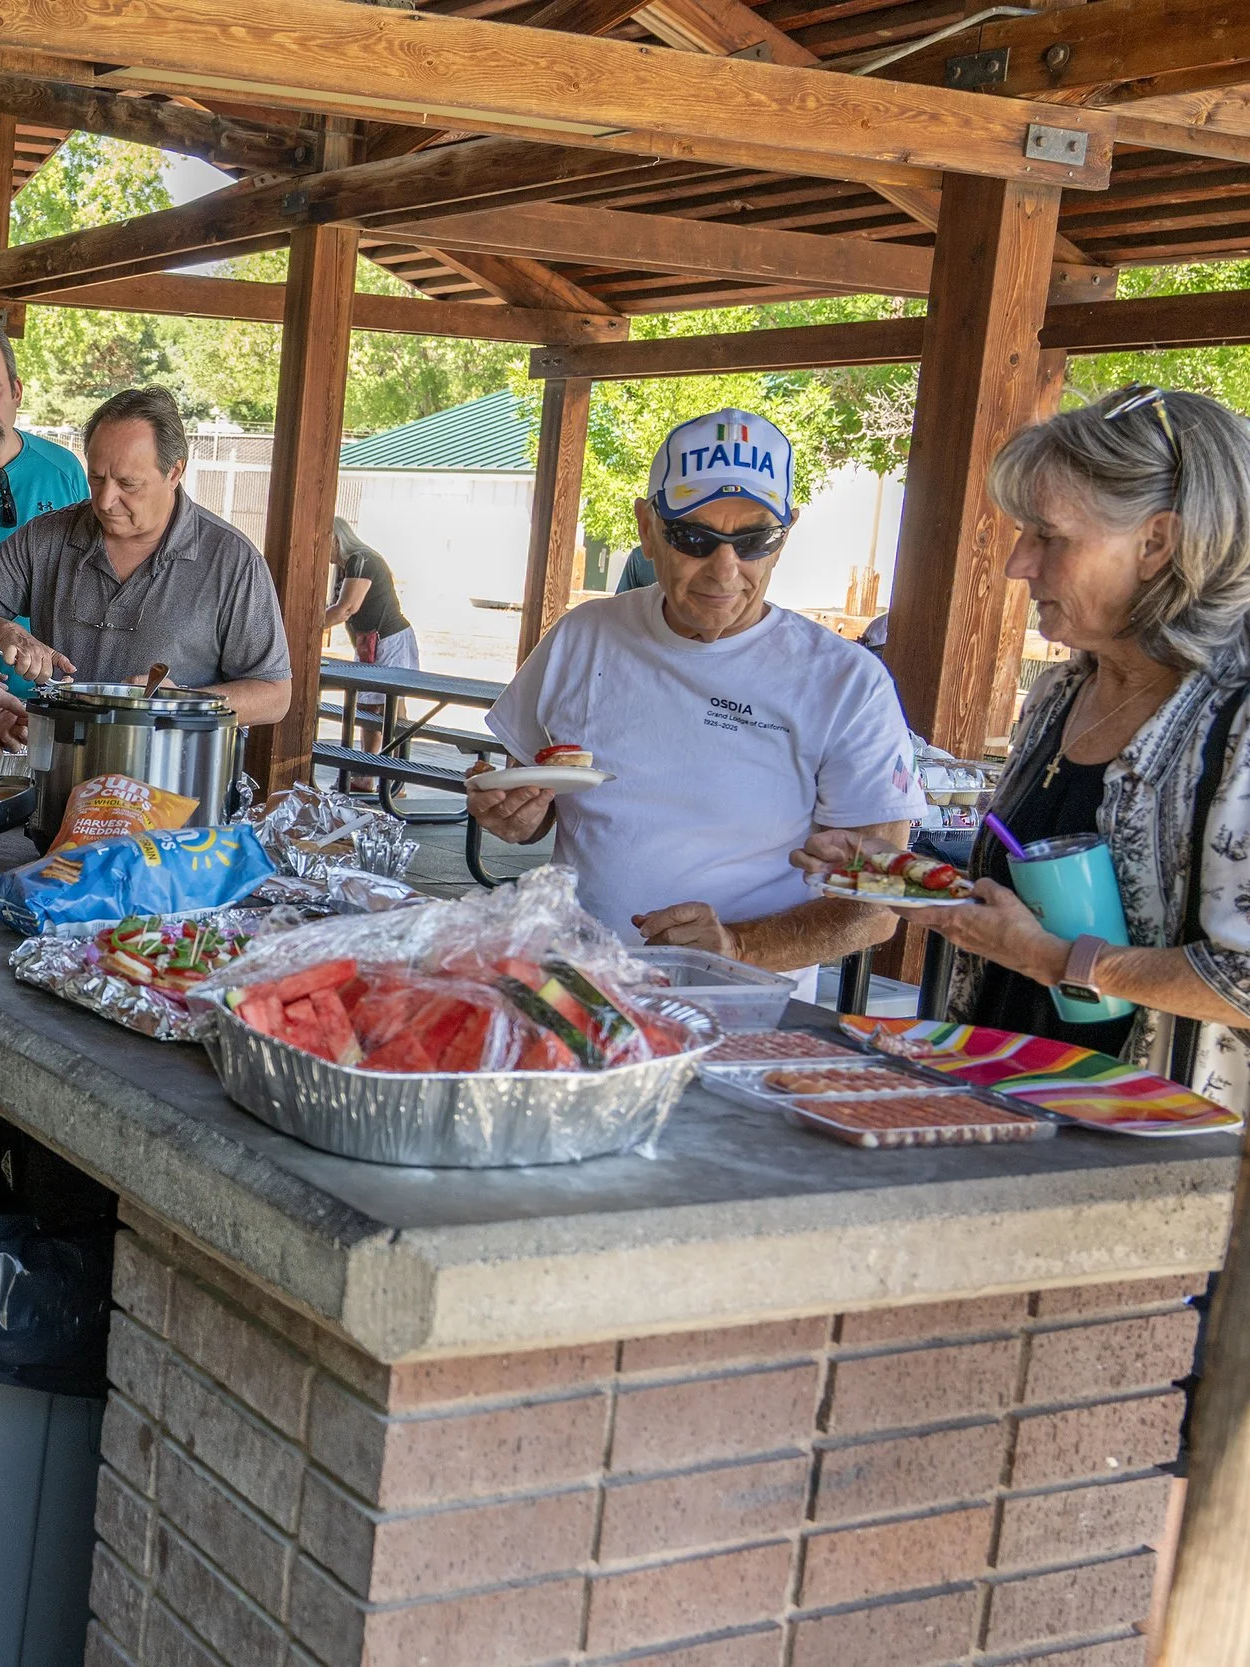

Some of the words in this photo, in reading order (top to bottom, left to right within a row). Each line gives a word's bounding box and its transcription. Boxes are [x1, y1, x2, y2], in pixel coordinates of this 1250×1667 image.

[681, 442, 775, 480] ITALIA
[710, 697, 753, 716] OSDIA
[706, 710, 729, 720] Grand
[757, 721, 790, 734] California
[79, 776, 150, 800] Sun
[100, 788, 152, 812] CHIPS
[72, 826, 130, 836] CHEDDAR
[74, 818, 132, 829] HARVEST
